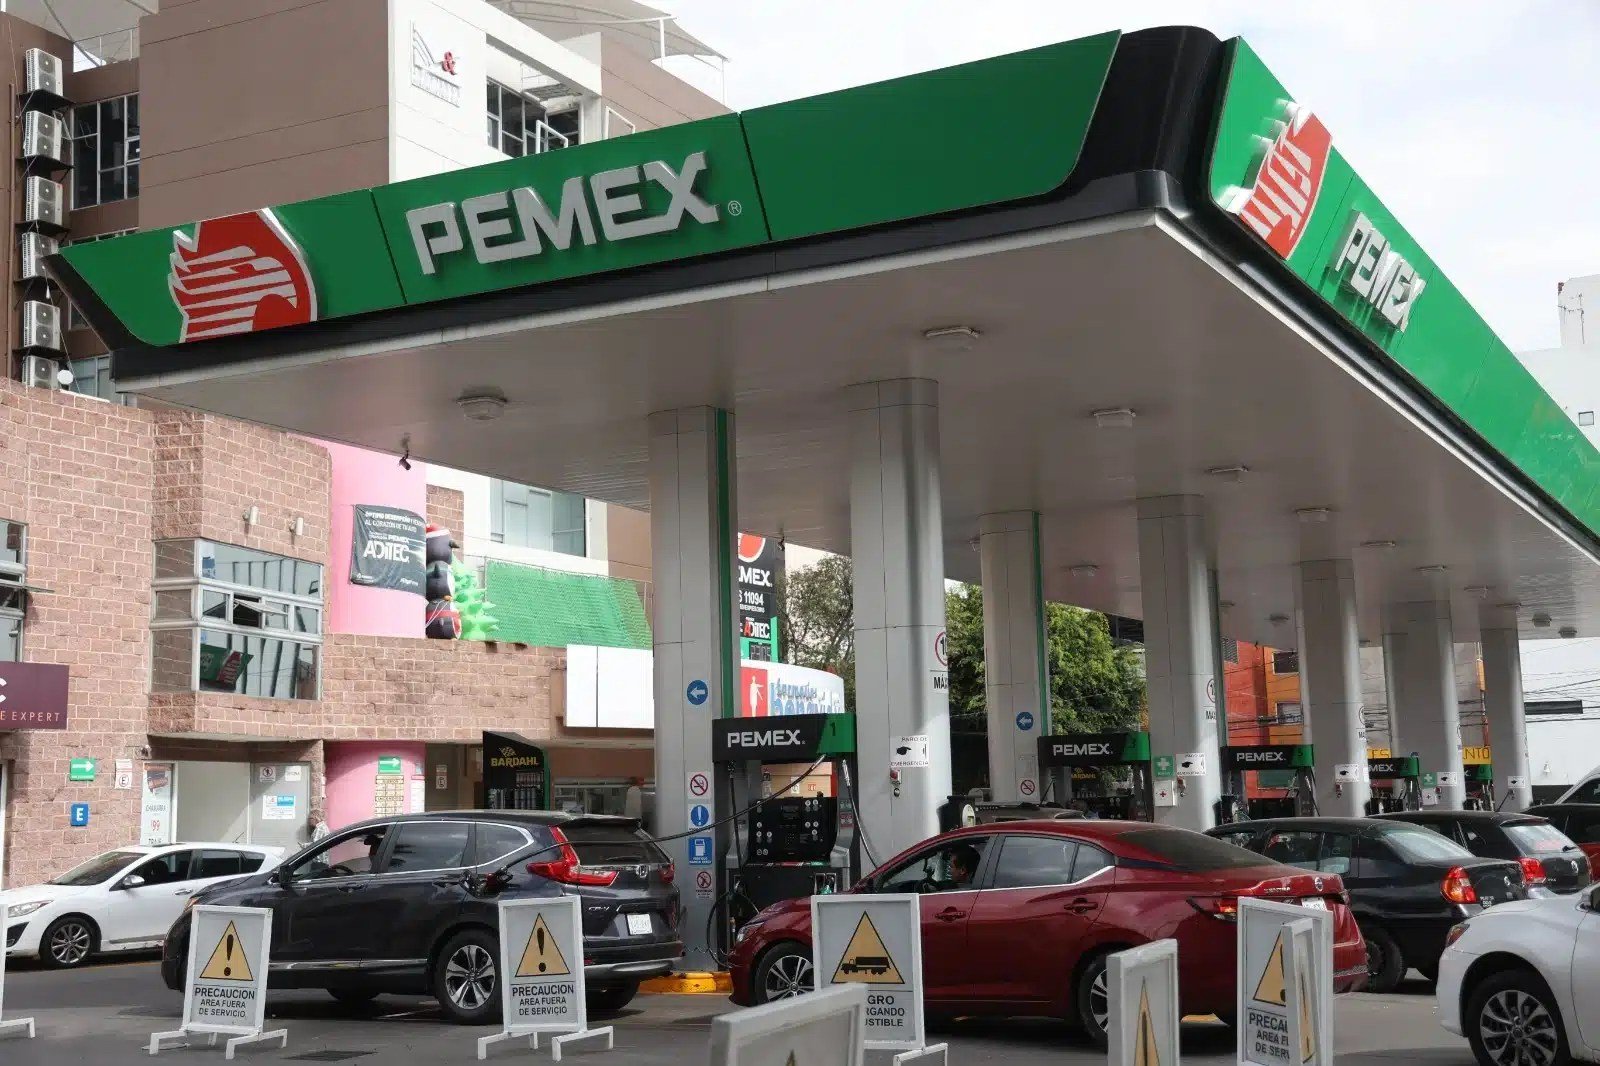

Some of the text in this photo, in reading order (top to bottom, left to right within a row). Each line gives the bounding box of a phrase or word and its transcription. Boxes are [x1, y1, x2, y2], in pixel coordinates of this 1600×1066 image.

[405, 151, 720, 275] PEMEX
[1334, 211, 1427, 333] PEMEX
[744, 591, 764, 605] 11094
[11, 711, 60, 722] EXPERT
[727, 729, 801, 748] PEMEX
[1052, 742, 1110, 757] PEMEX
[490, 756, 539, 768] BARDAHL
[1236, 752, 1283, 762] PEMEX
[76, 807, 84, 822] E
[194, 987, 255, 1000] PRECAUCION
[512, 984, 574, 997] PRECAUCION
[200, 999, 246, 1009] AREA FUERA
[520, 996, 567, 1006] AREA FUERA
[867, 995, 895, 1005] GRO
[199, 1007, 246, 1018] DE SERVICIO
[519, 1006, 568, 1016] DE SERVICIO
[1256, 1029, 1280, 1045] AREA
[1255, 1042, 1268, 1054] DE
